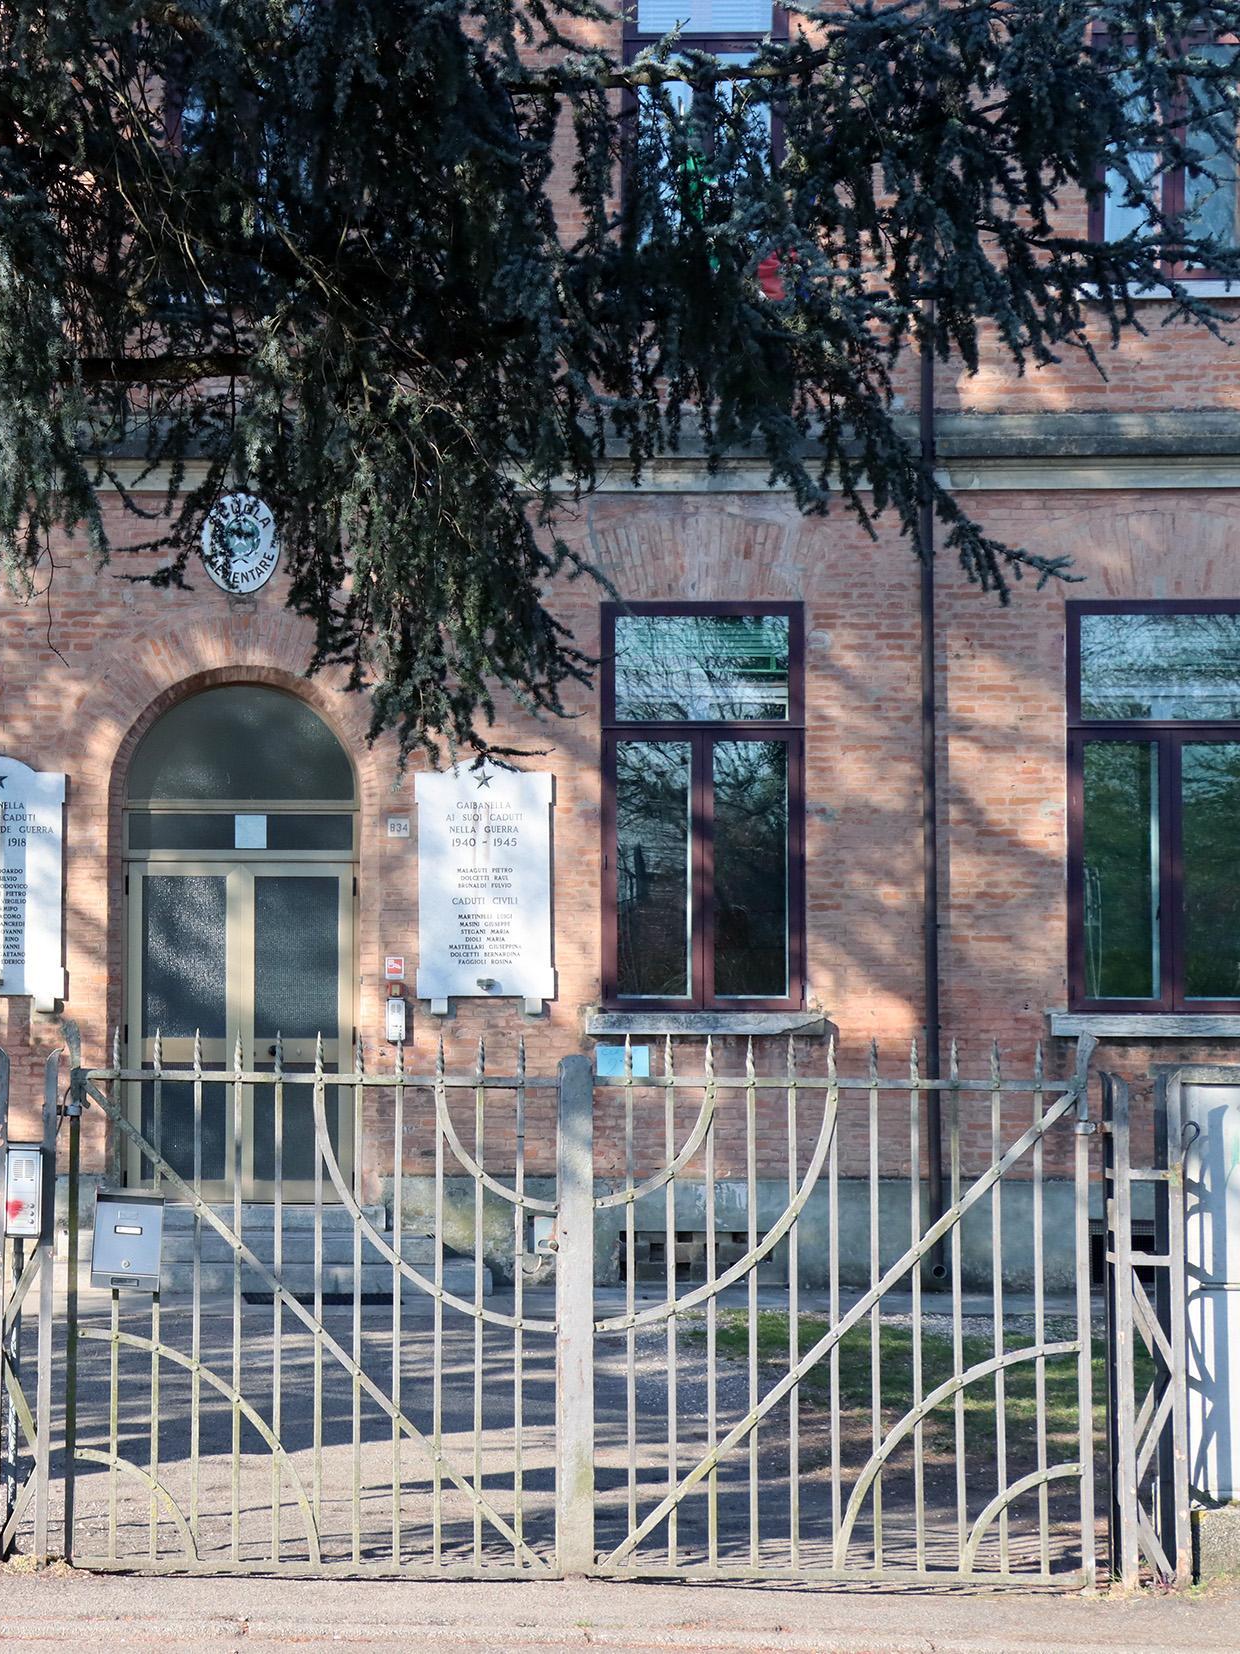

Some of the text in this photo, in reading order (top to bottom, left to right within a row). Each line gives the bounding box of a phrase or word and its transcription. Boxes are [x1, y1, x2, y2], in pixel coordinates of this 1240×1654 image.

[456, 801, 512, 810] GAIBANELLA
[3, 813, 36, 822] CADUTI
[446, 813, 523, 822] AI SUOI CADUTI
[19, 825, 54, 834] GUERRA
[449, 825, 519, 834] NELLA GUERRA
[8, 837, 27, 847] 1918
[451, 837, 477, 847] 1940
[493, 837, 518, 847] 1945
[451, 896, 518, 905] CADUTI CIVILI
